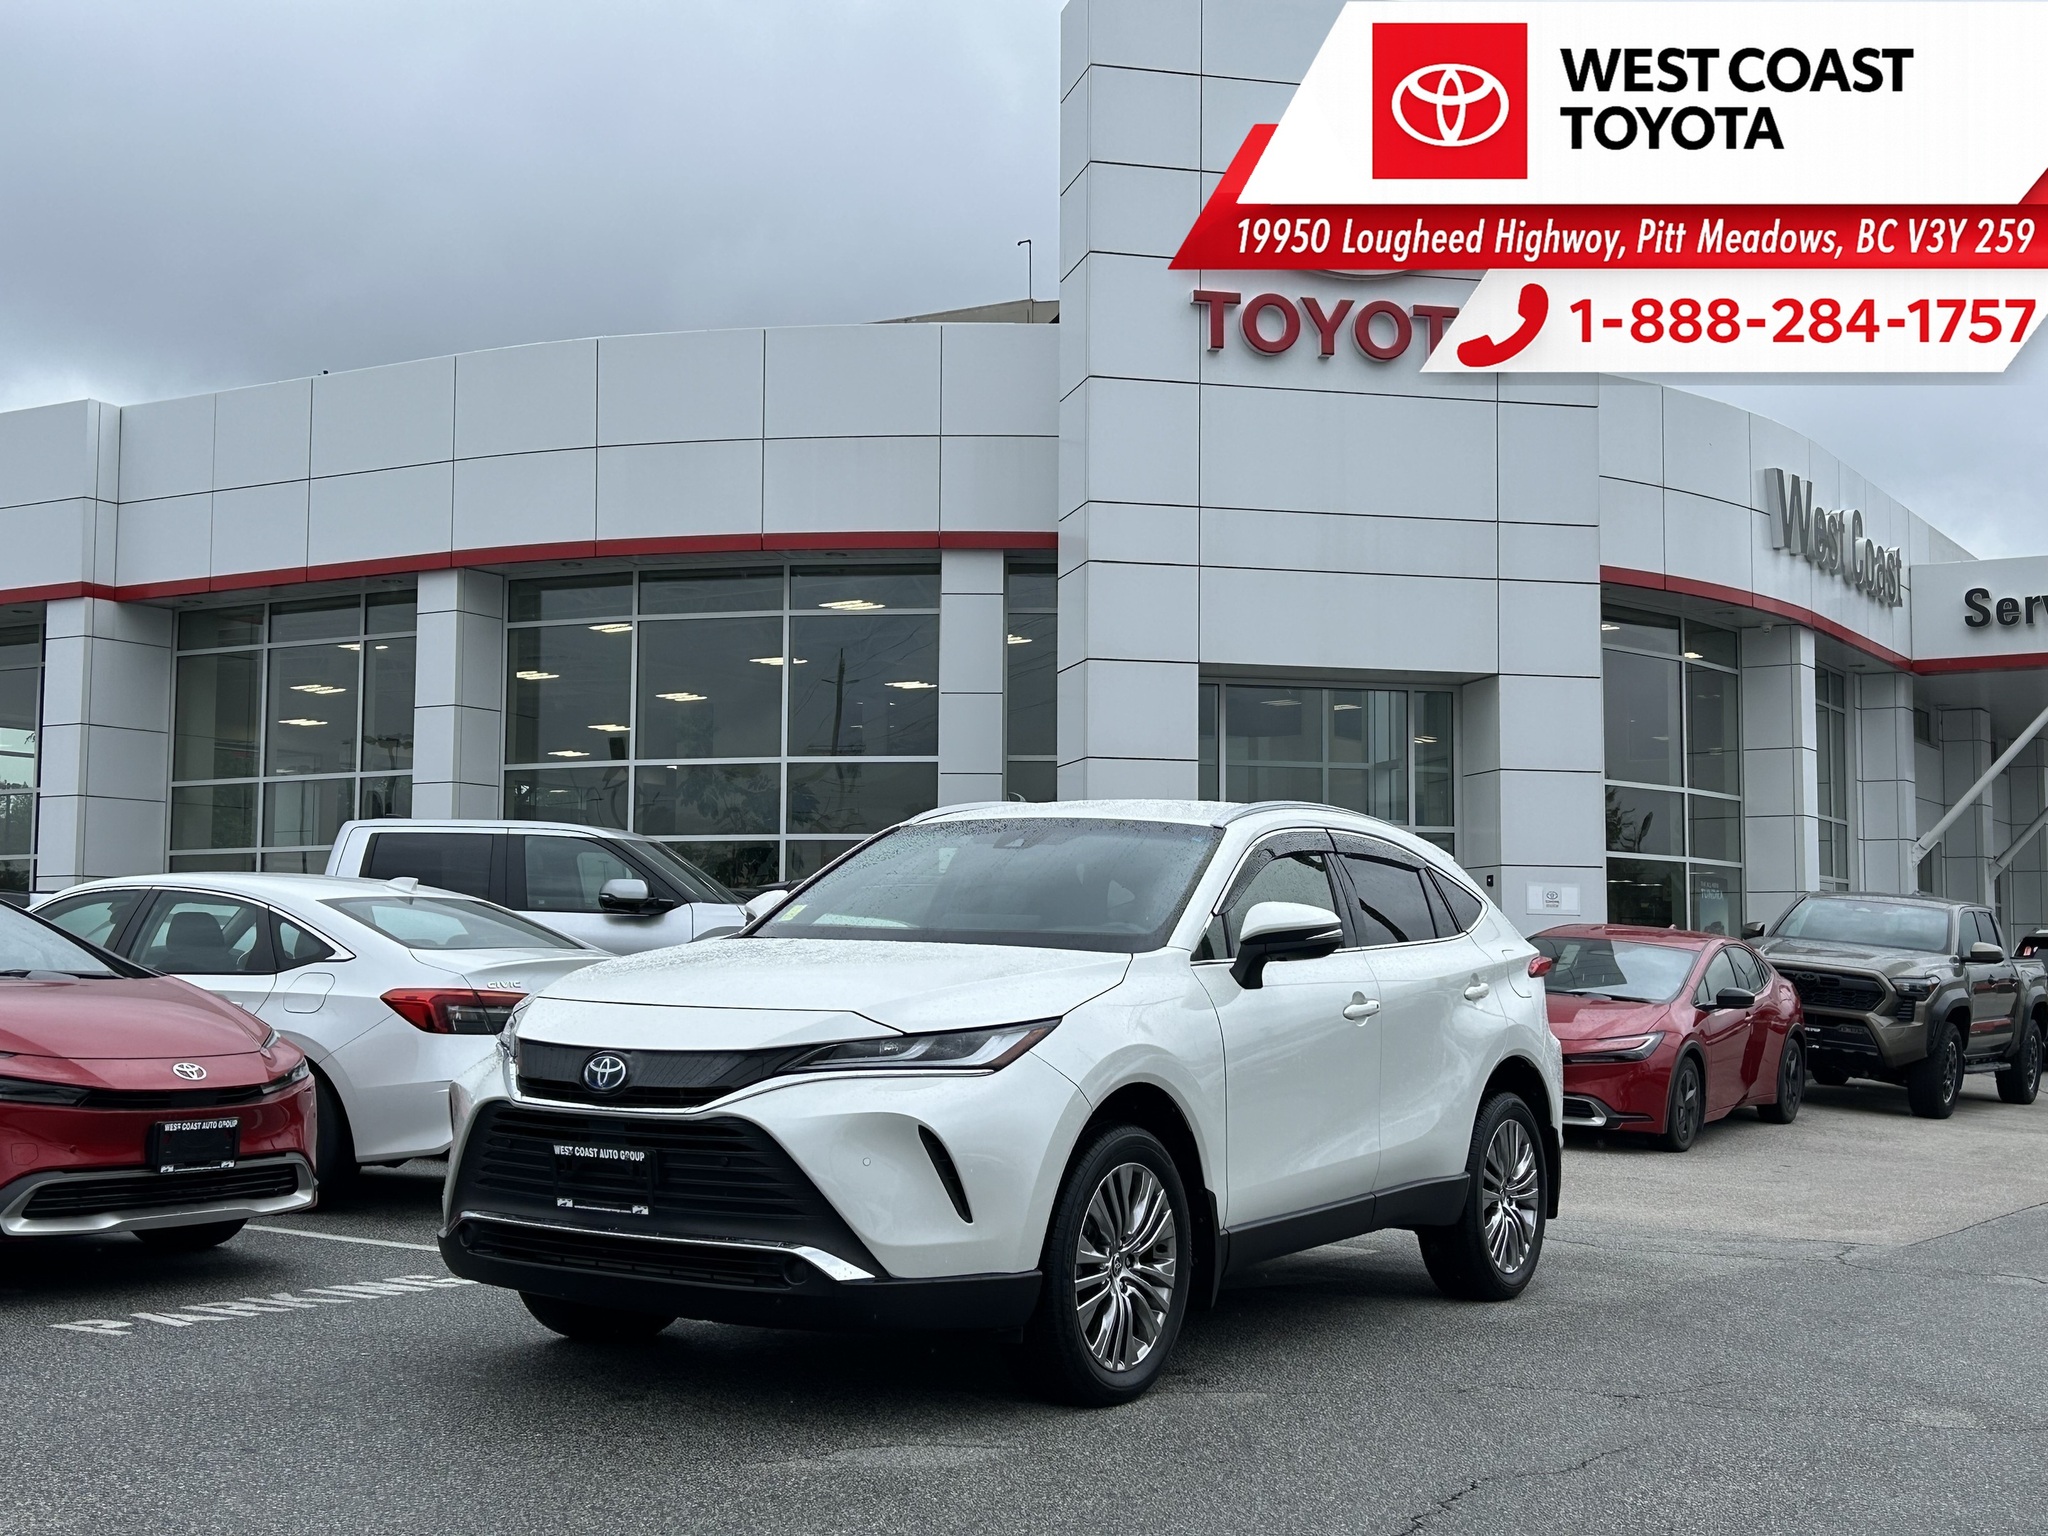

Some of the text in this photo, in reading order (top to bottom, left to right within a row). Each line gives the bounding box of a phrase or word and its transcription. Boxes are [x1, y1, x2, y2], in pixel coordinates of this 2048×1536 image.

[1764, 467, 1902, 608] West Coast
[487, 981, 521, 989] CIVIC
[182, 1122, 201, 1131] COAST
[202, 1121, 217, 1129] AUTO
[574, 1146, 598, 1158] COAST
[599, 1149, 619, 1159] AUTO
[47, 1274, 480, 1336] PARKING
